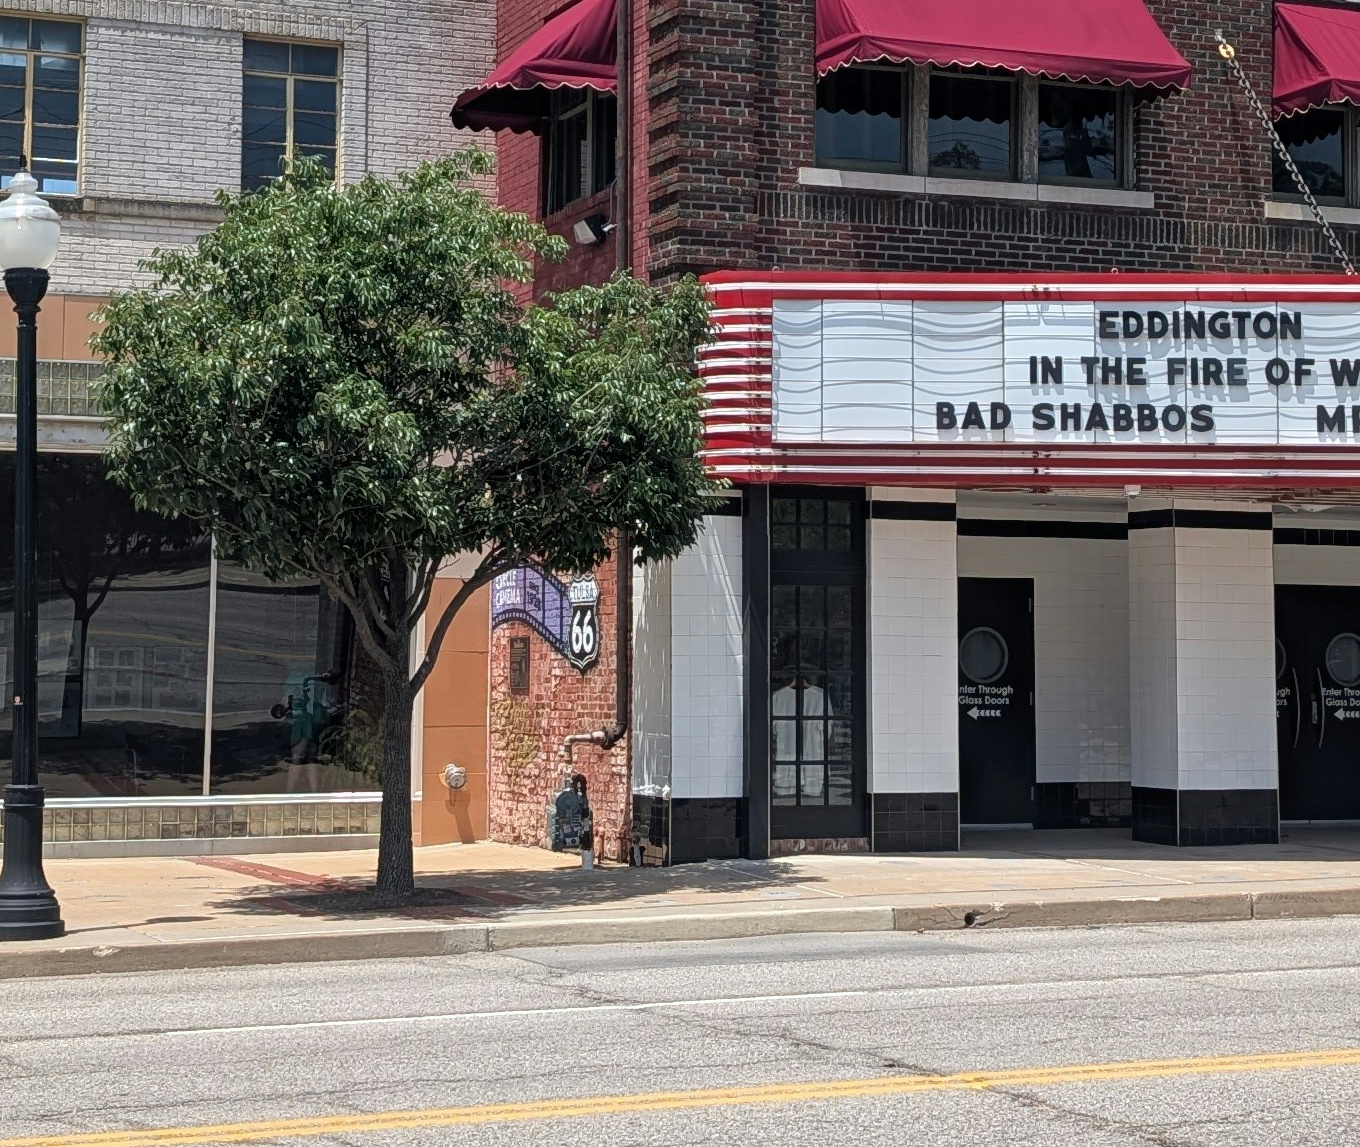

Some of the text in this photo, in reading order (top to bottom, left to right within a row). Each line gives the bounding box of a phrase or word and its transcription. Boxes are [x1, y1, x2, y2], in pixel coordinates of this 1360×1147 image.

[1099, 310, 1302, 340] EDDINGTON
[1029, 356, 1063, 385] IN
[1081, 356, 1146, 385] THE
[1167, 357, 1248, 386] FIRE
[1264, 358, 1316, 386] OF
[936, 401, 1012, 430] BAD
[1031, 403, 1215, 432] SHABBOS
[572, 585, 595, 602] TULSA
[571, 609, 595, 654] 66
[959, 684, 1014, 697] nter Through
[984, 695, 1010, 705] Doors
[1325, 697, 1348, 707] Glass
